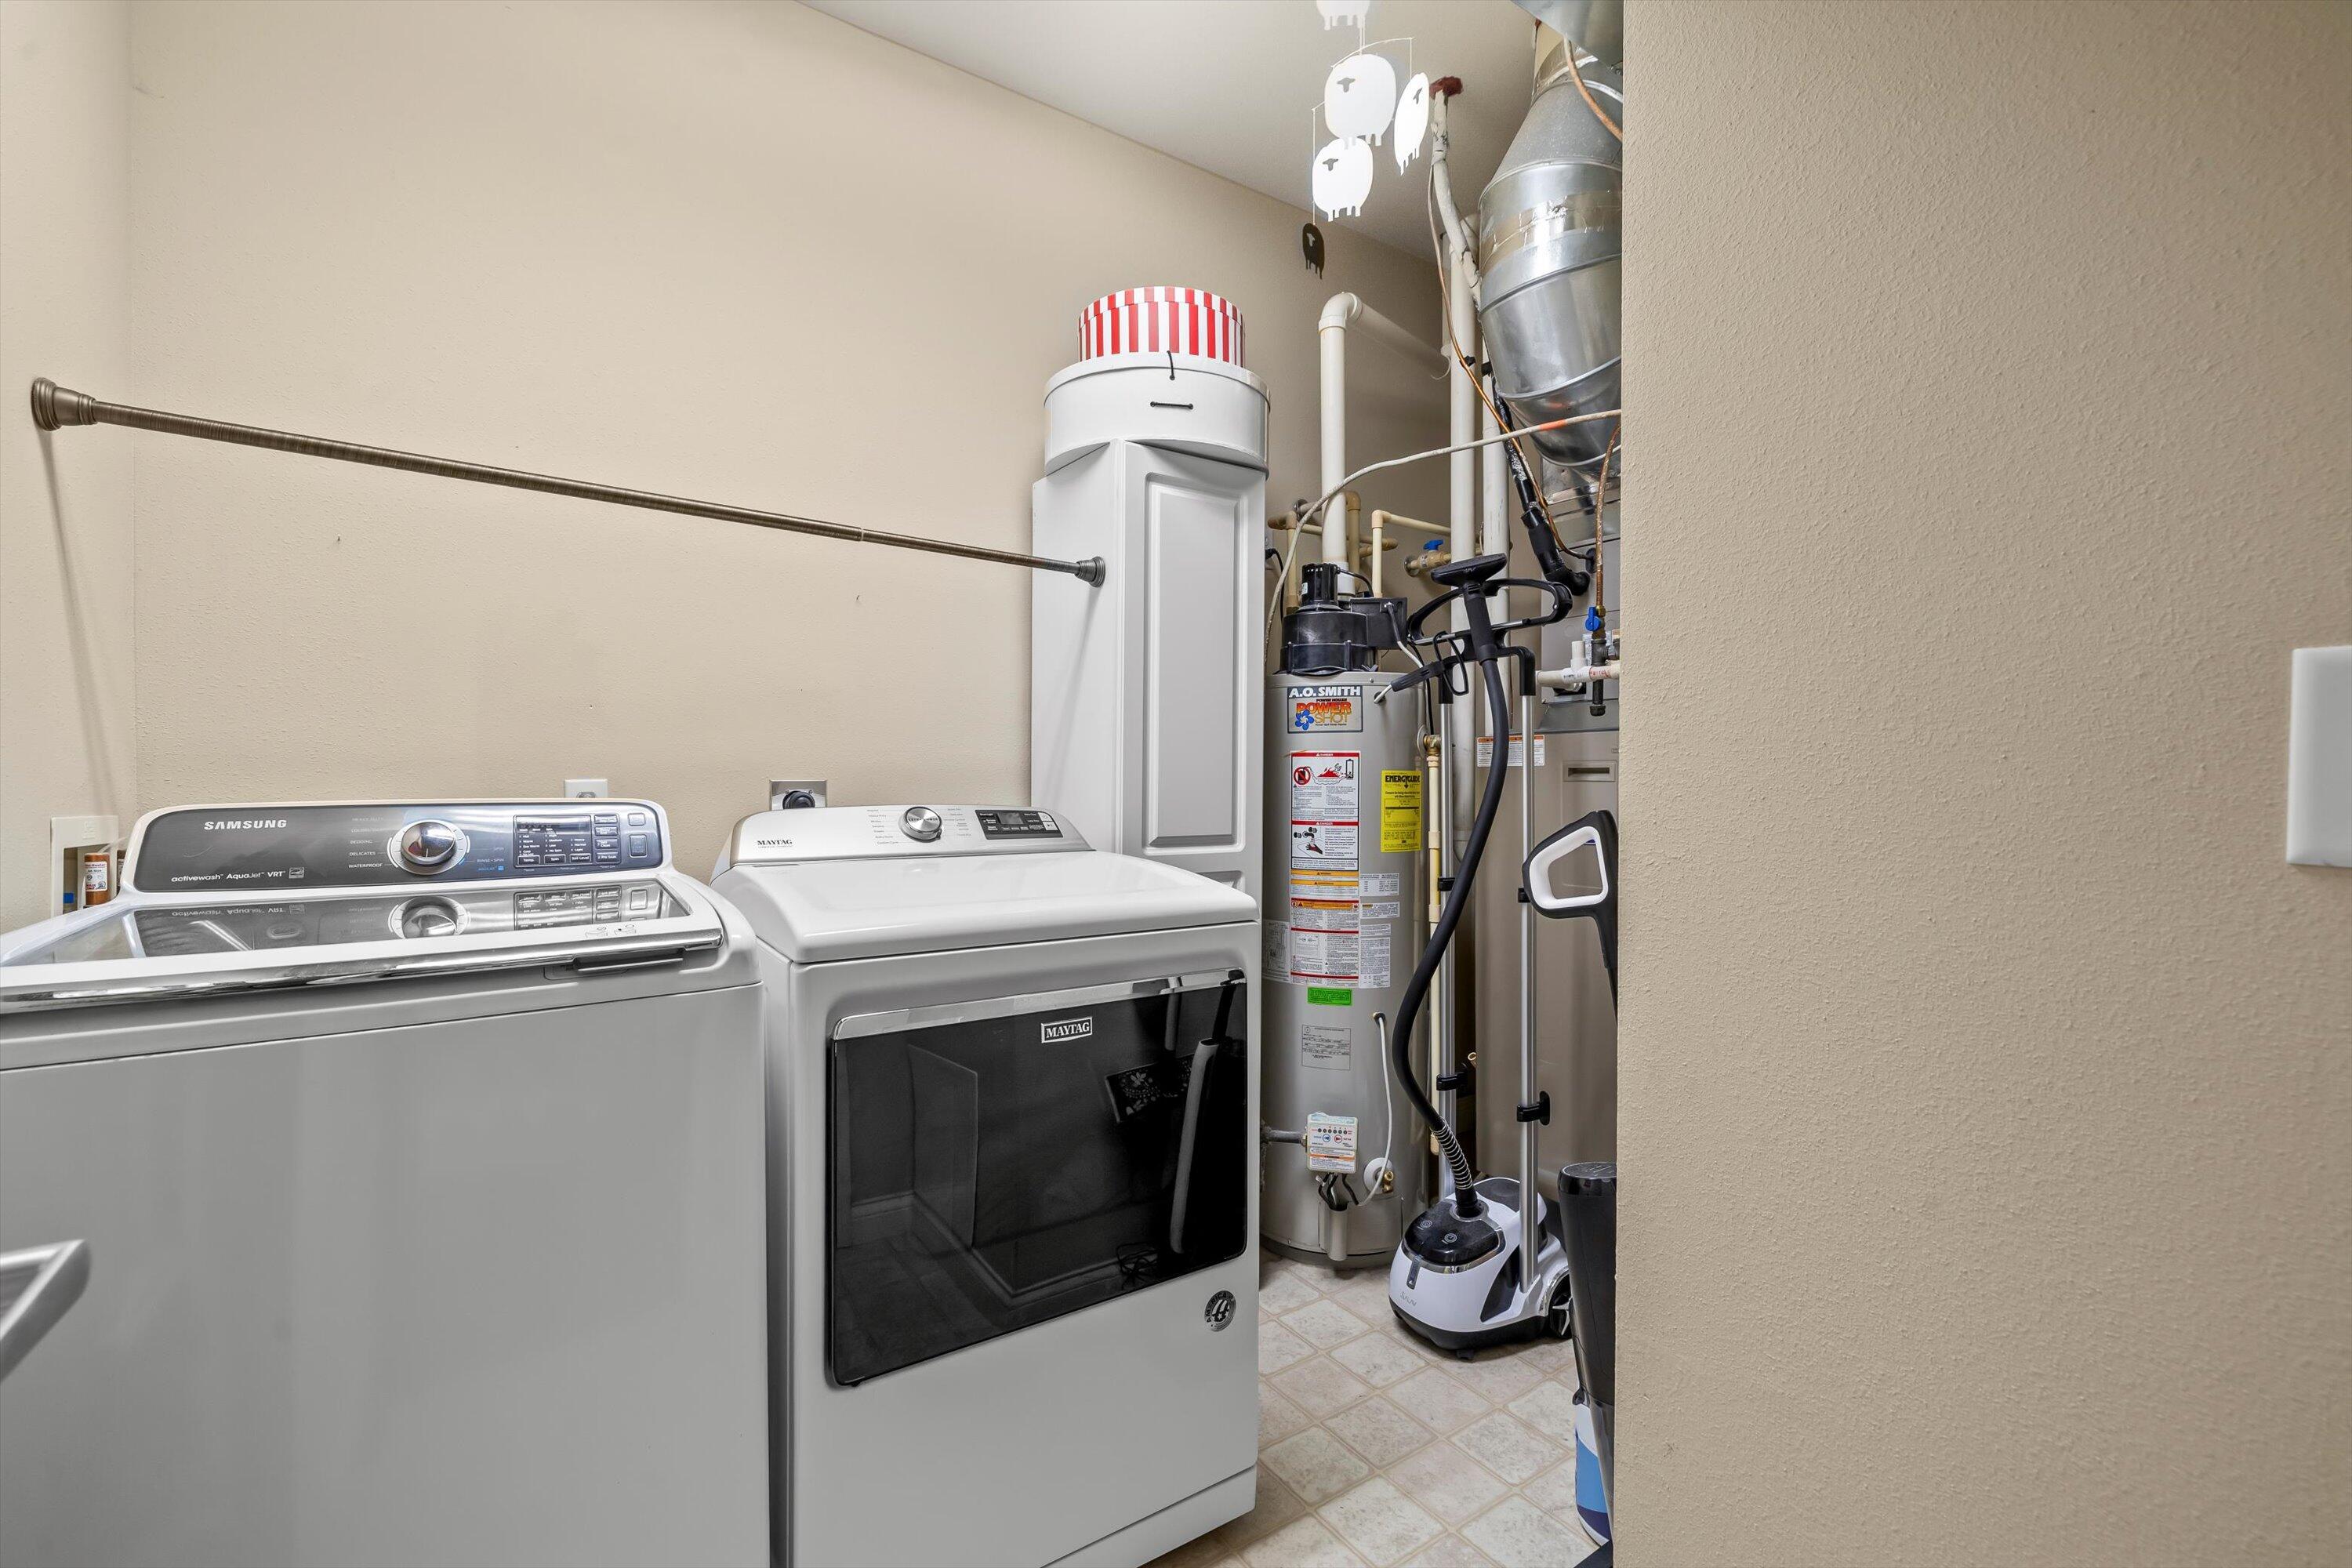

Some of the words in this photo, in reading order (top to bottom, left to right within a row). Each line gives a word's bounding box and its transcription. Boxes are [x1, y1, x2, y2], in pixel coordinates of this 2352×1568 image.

[1289, 688, 1317, 698] A.O.
[1318, 686, 1361, 697] SMITH
[1296, 701, 1352, 714] POWER
[1315, 713, 1348, 724] SHOT
[204, 819, 287, 830] SAMSUNG
[1046, 1022, 1090, 1039] MAYTAG
